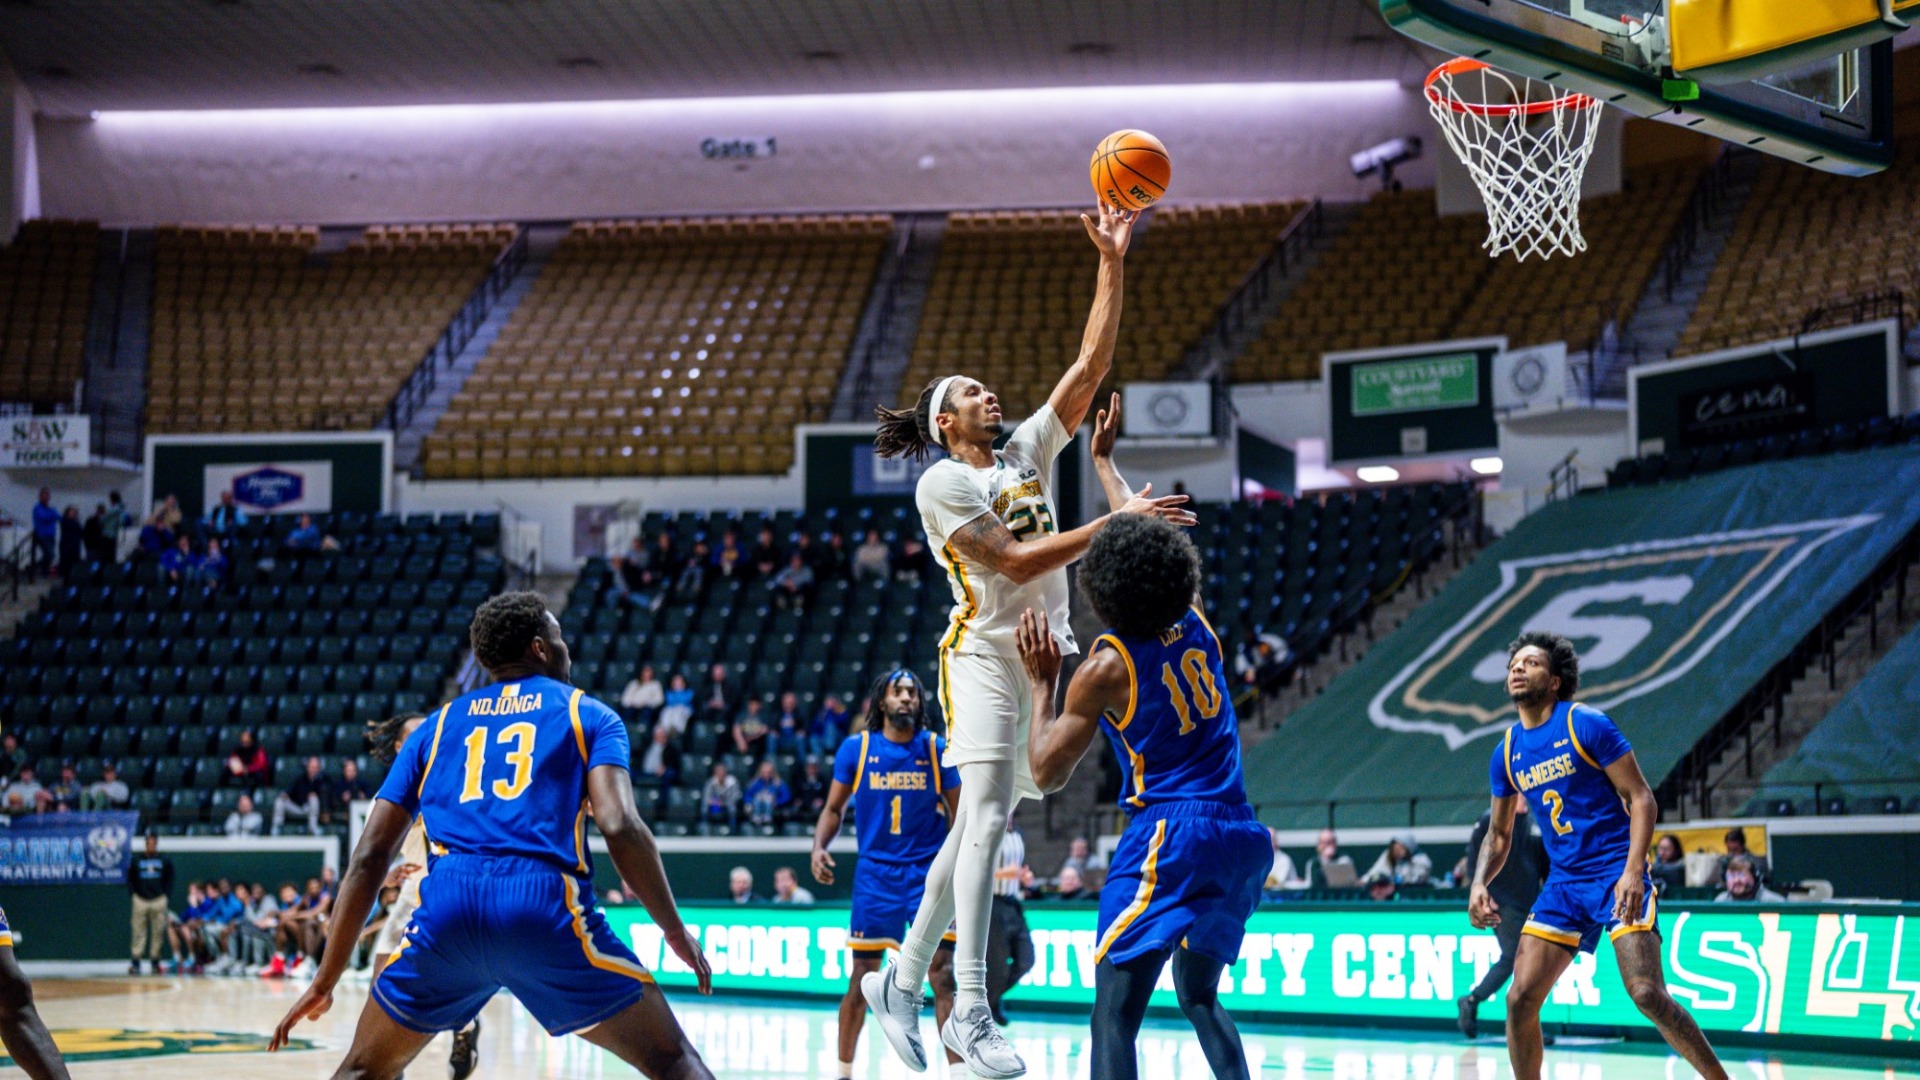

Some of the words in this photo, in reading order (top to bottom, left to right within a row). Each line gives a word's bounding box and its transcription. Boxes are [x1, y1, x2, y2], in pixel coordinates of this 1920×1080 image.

[701, 137, 756, 158] Gate
[765, 137, 777, 155] 1
[467, 692, 542, 716] NDJONGA
[1161, 647, 1222, 736] 10
[459, 721, 537, 805] 13
[868, 771, 928, 791] McNEESE
[1515, 752, 1577, 792] McNEESE
[889, 794, 902, 834] 1
[1542, 789, 1574, 837] 2
[817, 926, 853, 979] T
[1331, 933, 1601, 1007] CENTR
